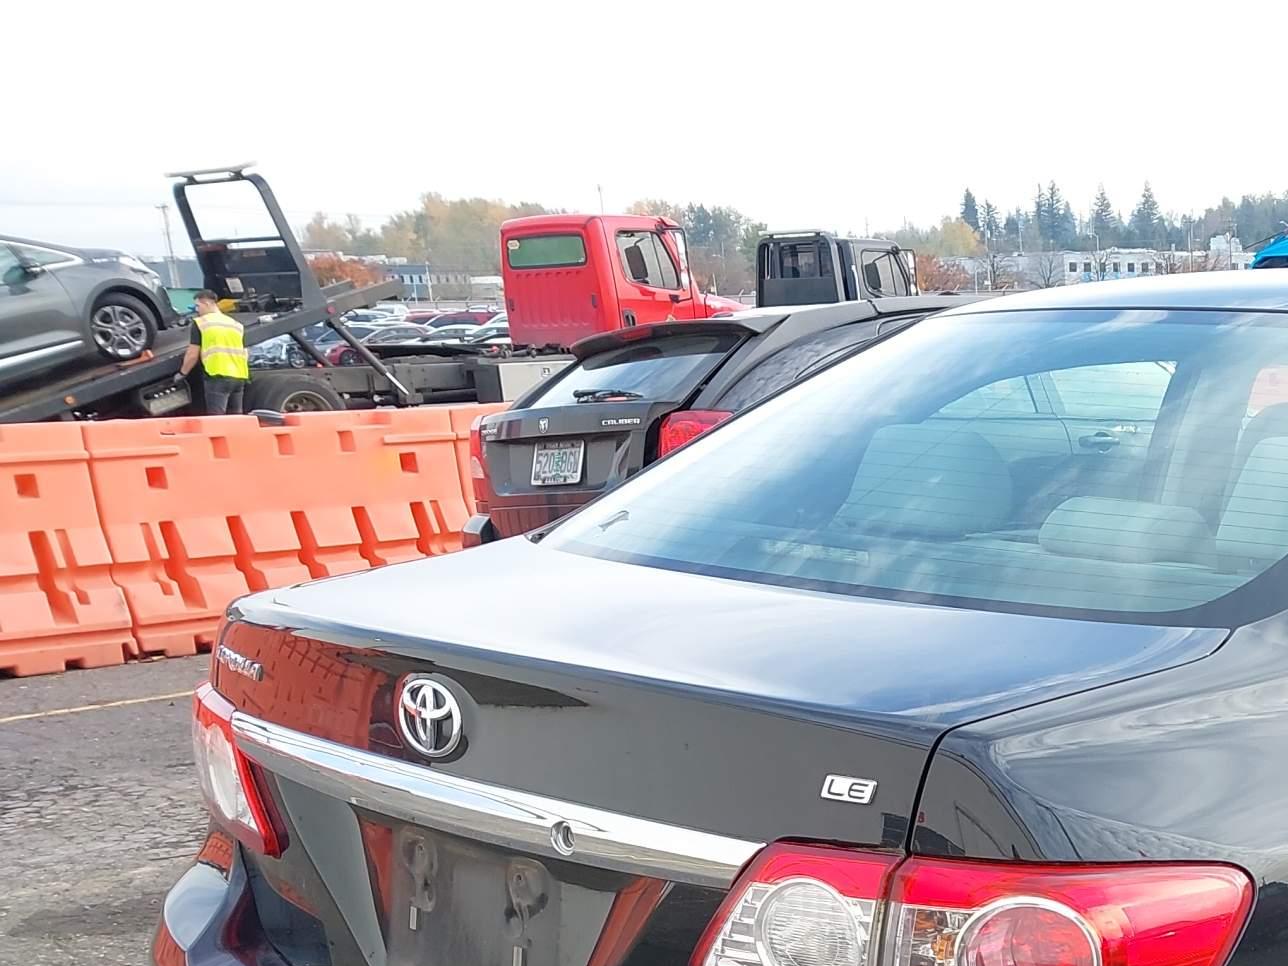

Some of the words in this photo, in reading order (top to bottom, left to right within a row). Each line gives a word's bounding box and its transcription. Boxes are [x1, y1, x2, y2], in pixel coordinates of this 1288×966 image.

[601, 417, 641, 426] CALIBER
[535, 452, 555, 474] 520
[825, 777, 871, 801] LE
